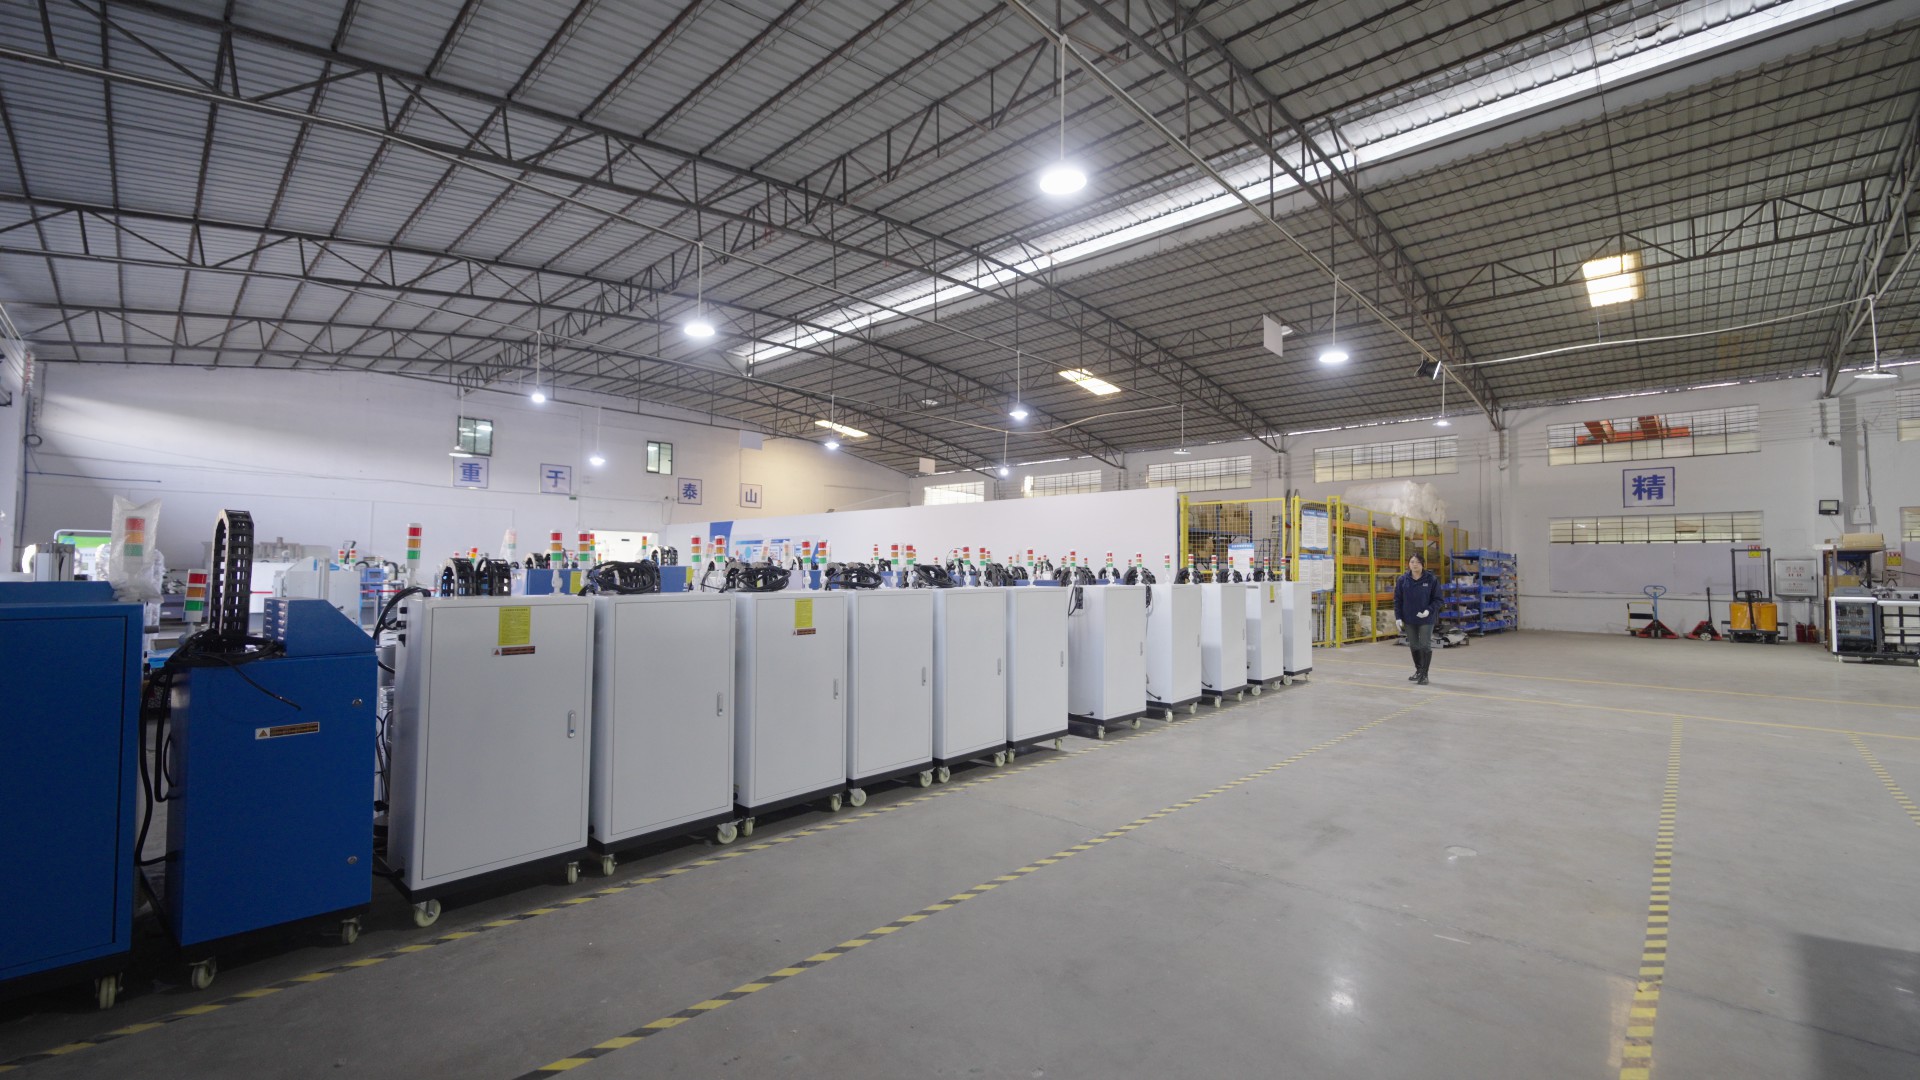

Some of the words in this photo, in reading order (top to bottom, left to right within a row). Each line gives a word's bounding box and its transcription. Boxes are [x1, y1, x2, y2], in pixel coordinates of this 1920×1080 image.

[460, 462, 483, 483] 重
[546, 469, 566, 488] 于
[682, 483, 698, 500] 泰
[745, 488, 758, 504] 山
[1632, 474, 1666, 501] 精
